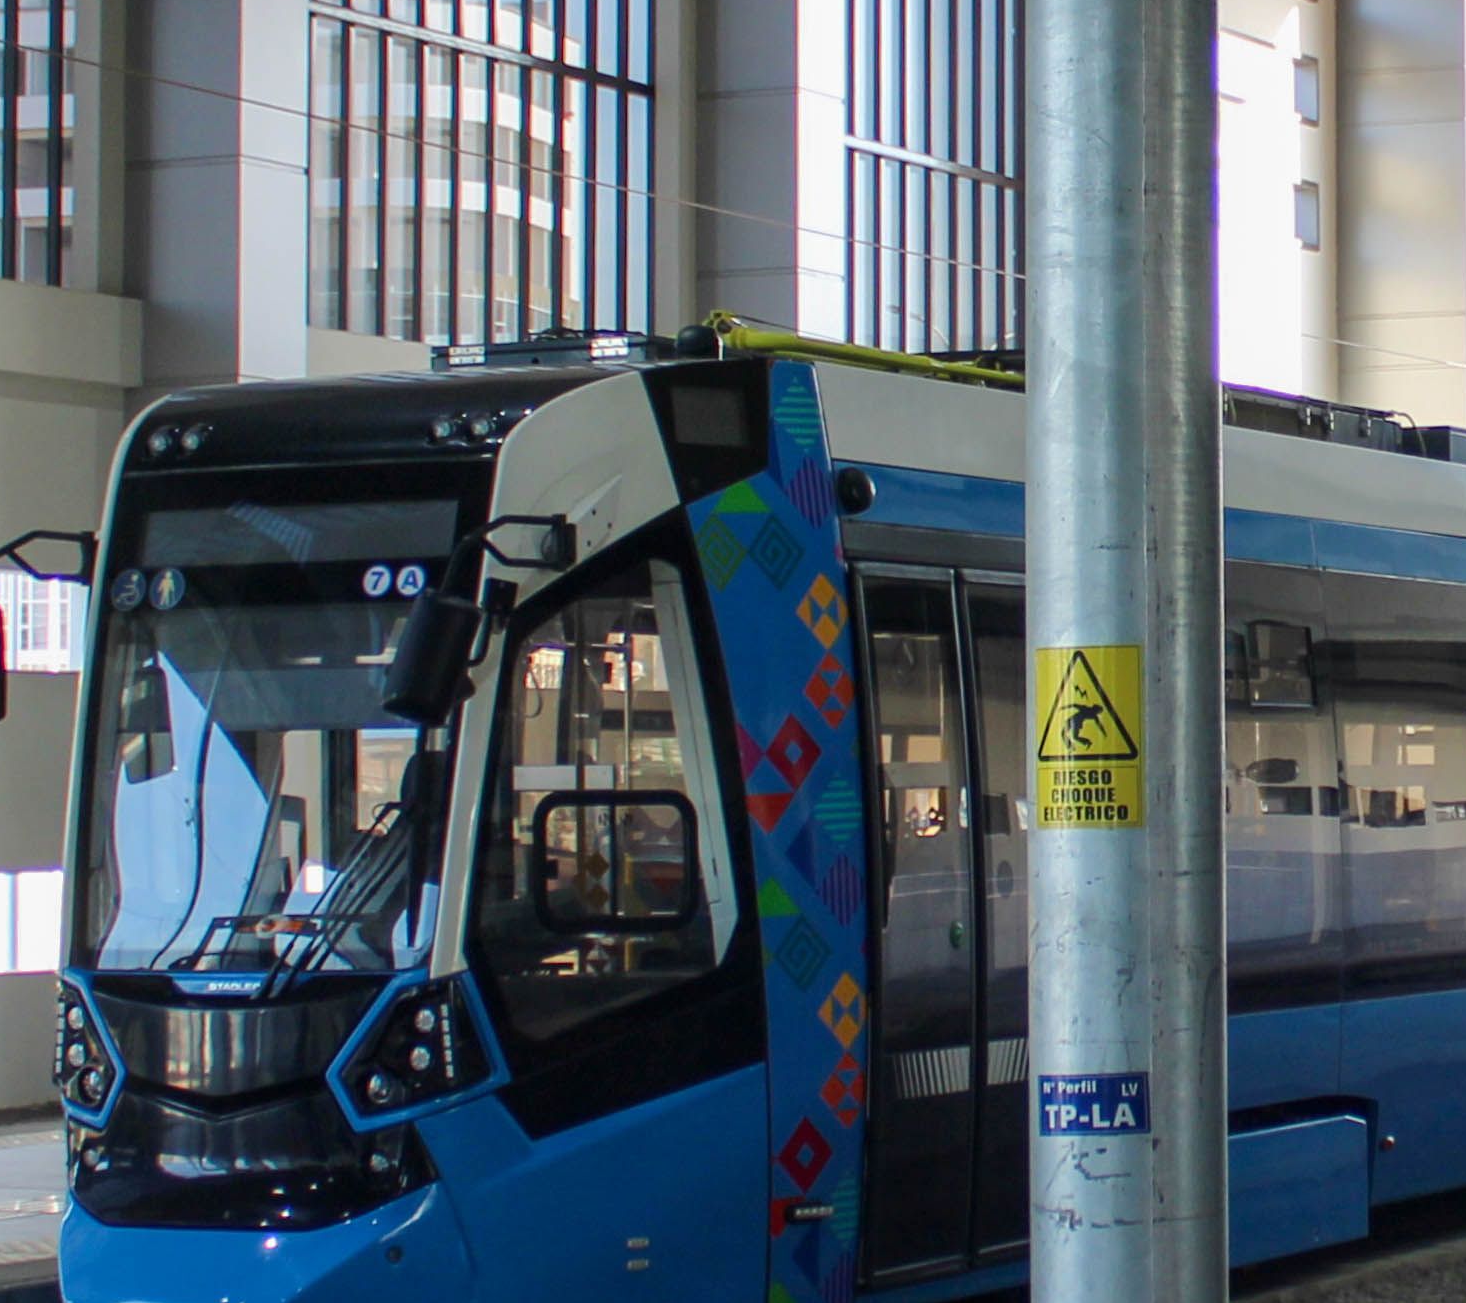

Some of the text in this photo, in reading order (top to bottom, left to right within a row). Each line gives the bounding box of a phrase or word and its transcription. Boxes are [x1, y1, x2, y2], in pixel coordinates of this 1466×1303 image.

[371, 569, 420, 591] 7 A
[1053, 769, 1112, 785] RIESGO
[1051, 788, 1116, 803] CHOQUE
[1044, 805, 1129, 821] ELECTRICO
[1058, 1080, 1096, 1094] Perfil
[1121, 1082, 1138, 1096] LV
[1045, 1102, 1136, 1129] TP-LA
